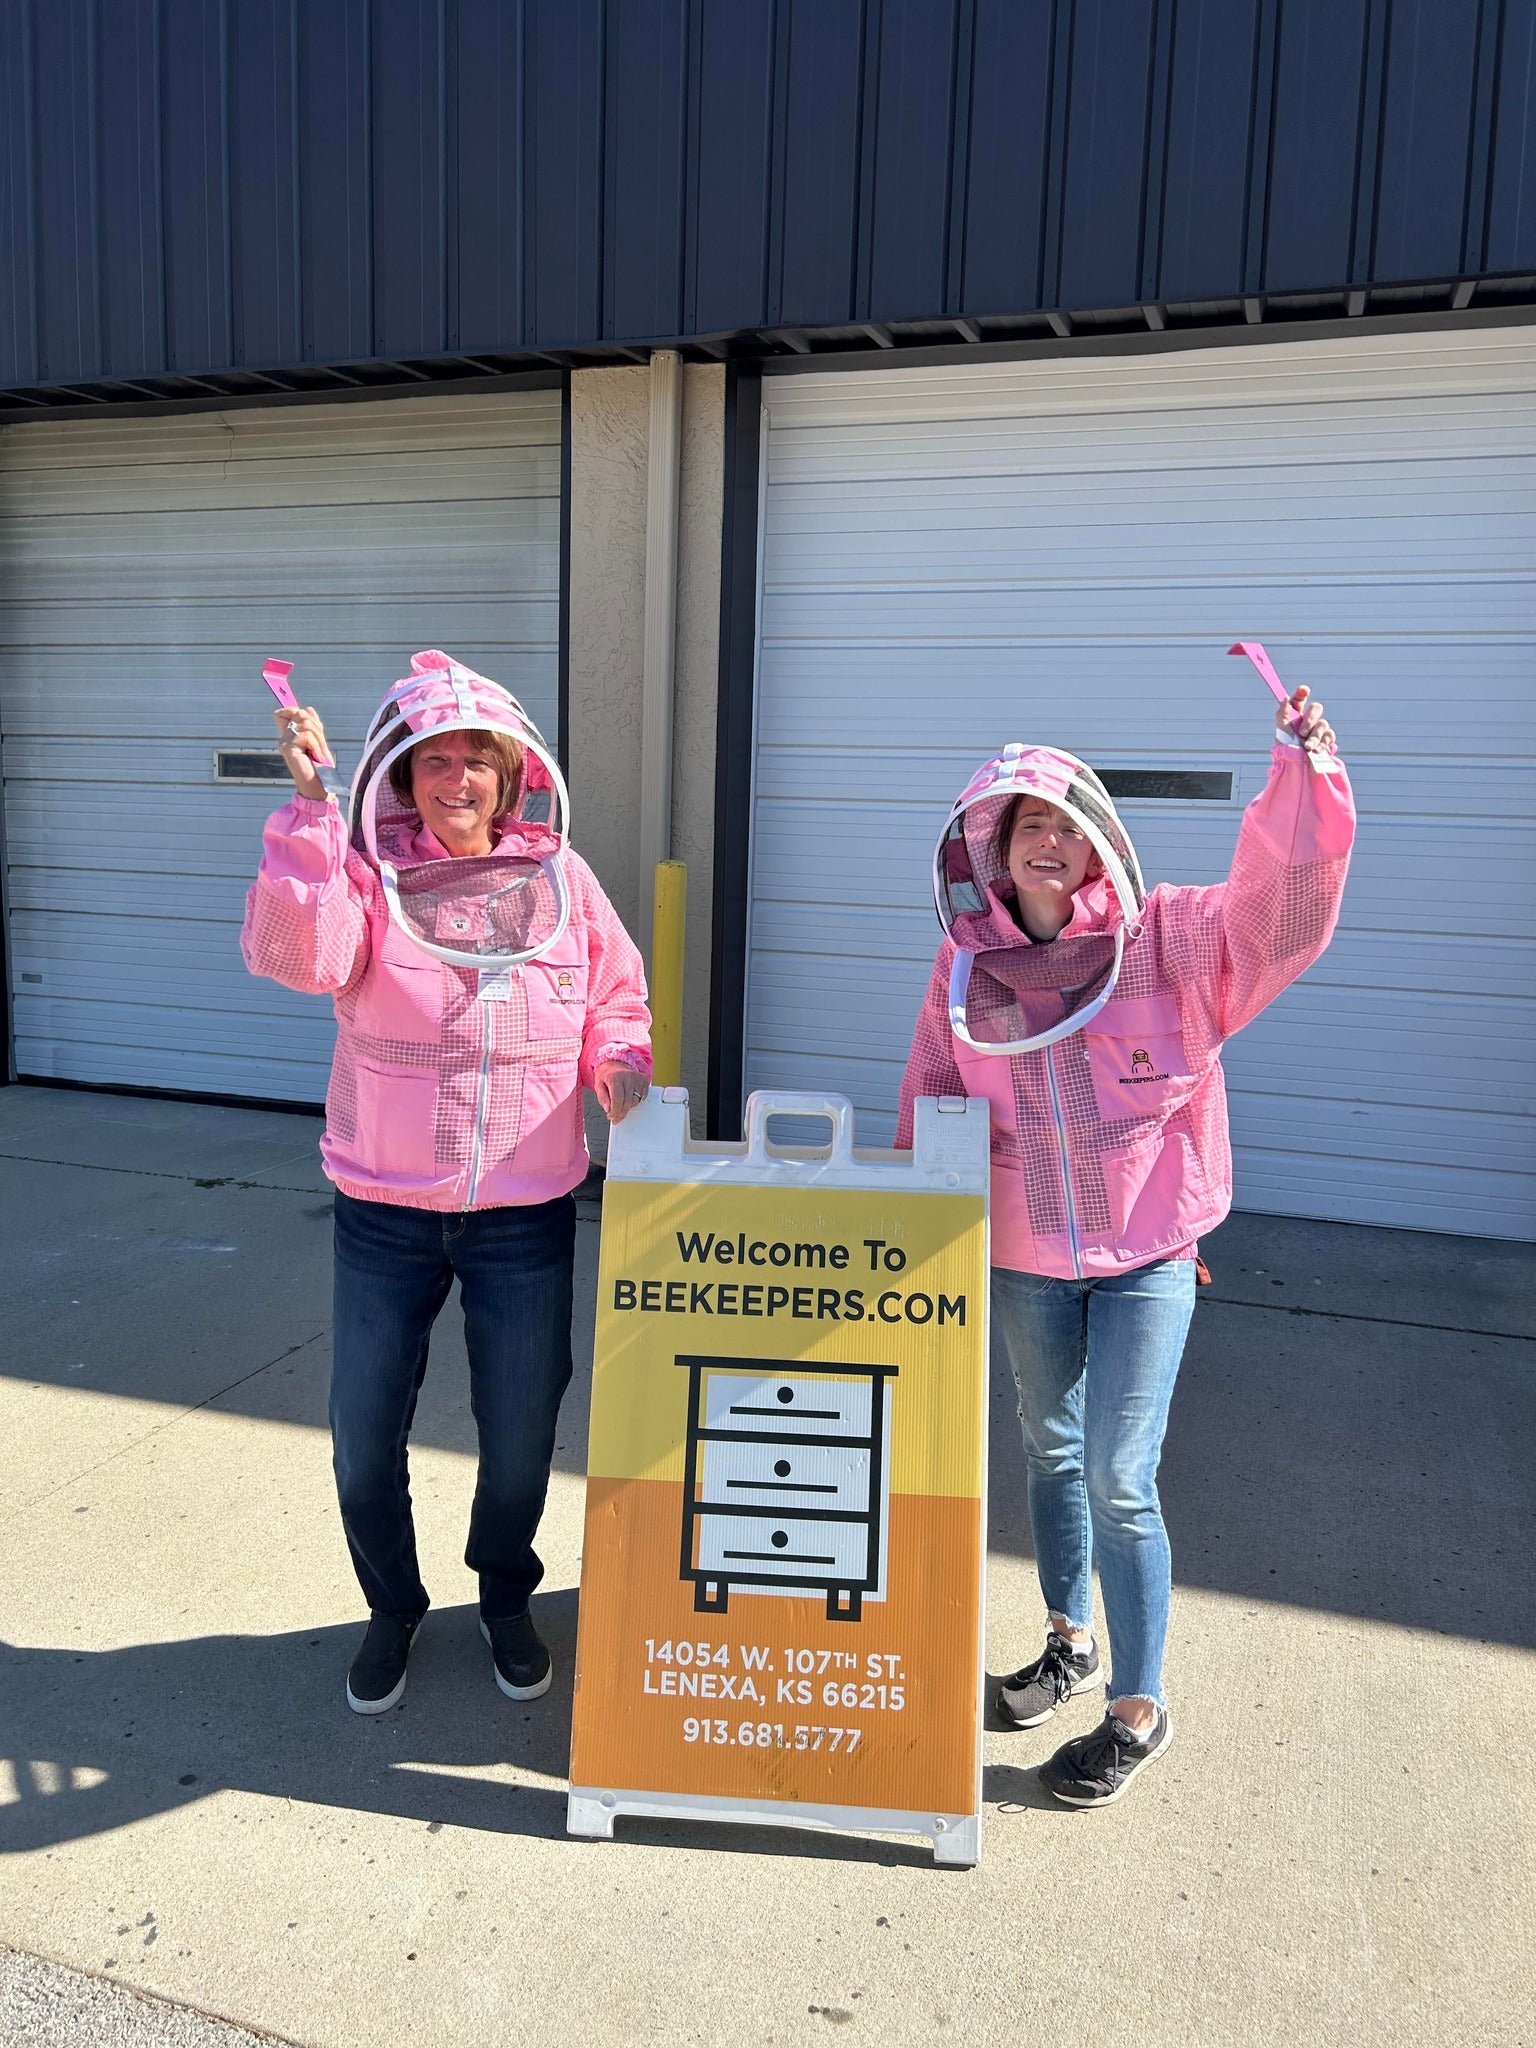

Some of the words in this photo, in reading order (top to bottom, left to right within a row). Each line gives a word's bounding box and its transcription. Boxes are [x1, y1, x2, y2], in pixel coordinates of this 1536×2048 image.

[1119, 1072, 1169, 1084] BEEKEEPERS.COM
[676, 1231, 850, 1270] Welcome
[863, 1239, 908, 1272] To
[613, 1279, 967, 1327] BEEKEEPERS.COM
[644, 1638, 730, 1669] 14054
[739, 1645, 774, 1672] W.
[866, 1653, 906, 1680] ST.
[643, 1669, 767, 1707] LENEXA,
[776, 1678, 813, 1706] KS
[822, 1681, 905, 1711] 66215
[683, 1717, 862, 1753] 913.681.5777
